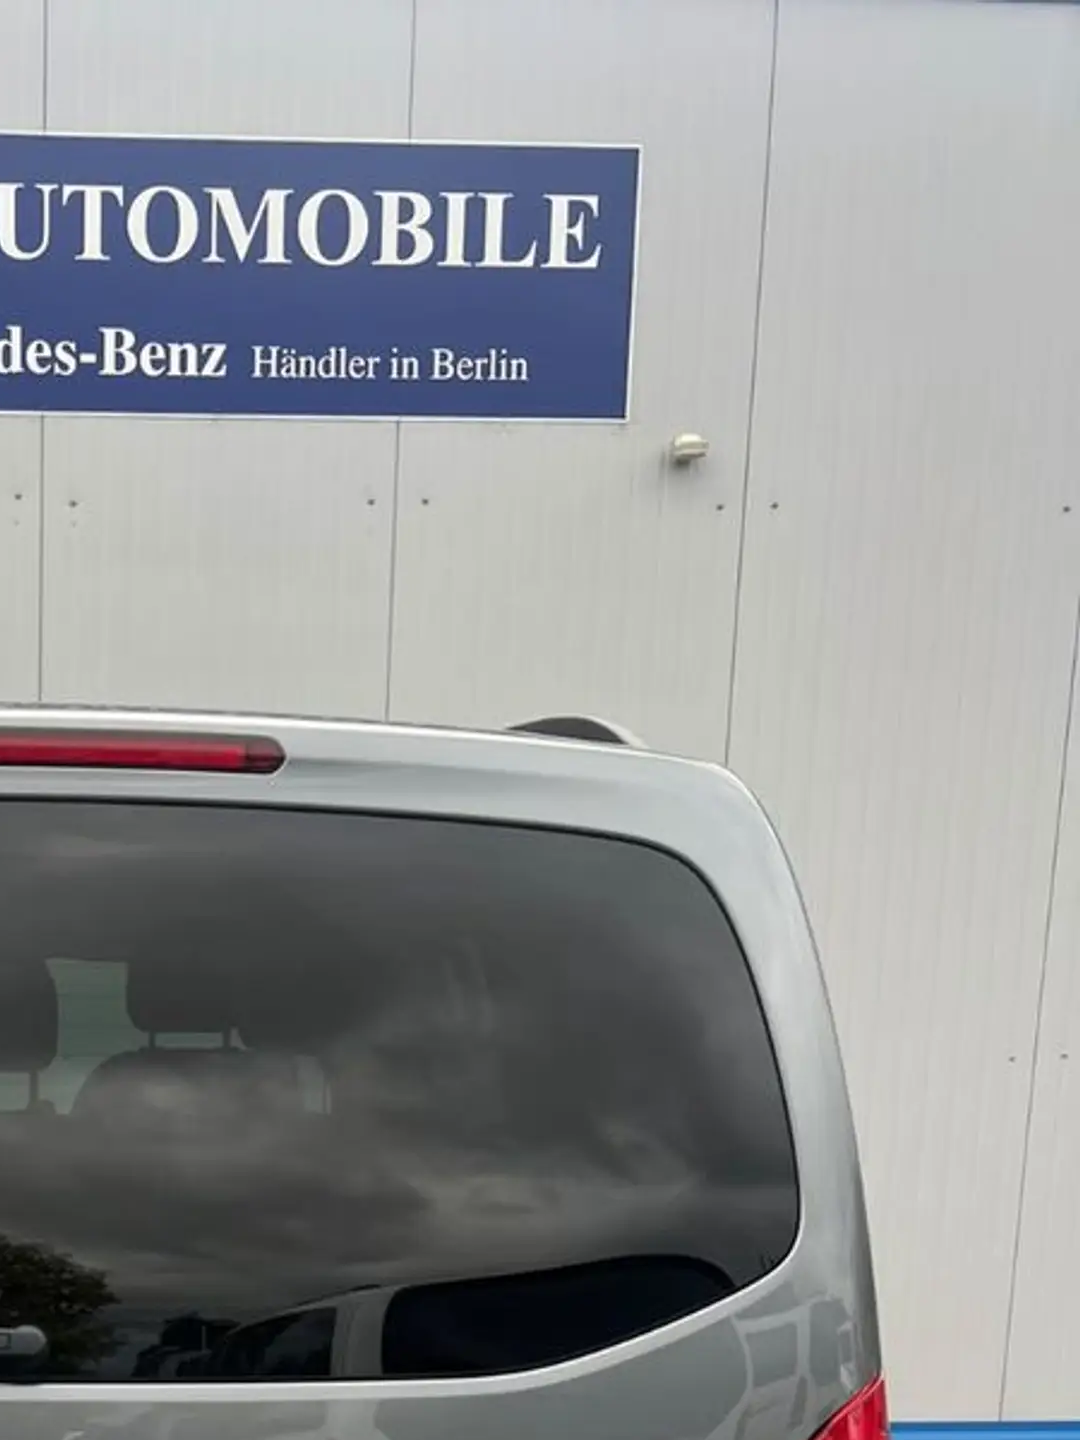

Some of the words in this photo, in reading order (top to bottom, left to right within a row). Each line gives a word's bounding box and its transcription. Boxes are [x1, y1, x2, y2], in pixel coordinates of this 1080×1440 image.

[252, 345, 381, 380] Händler
[390, 347, 420, 381] in
[431, 348, 529, 381] Berlin
